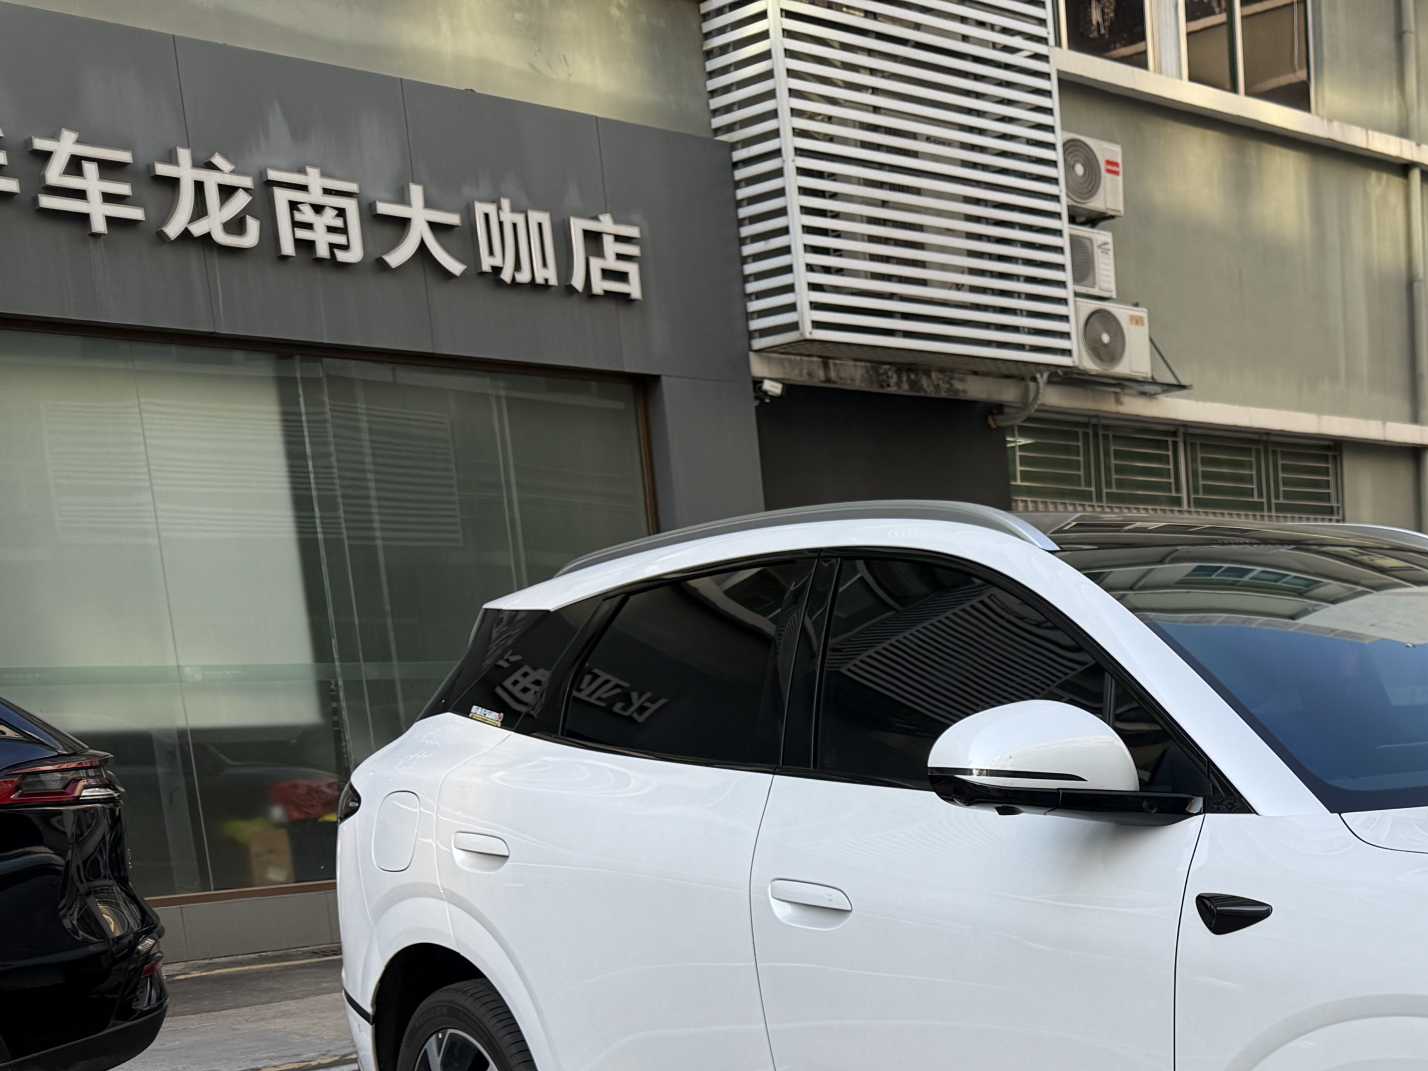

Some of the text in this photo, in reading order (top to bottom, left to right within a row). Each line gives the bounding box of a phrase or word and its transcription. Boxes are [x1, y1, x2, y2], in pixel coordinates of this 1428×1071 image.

[0, 127, 643, 301] 车龙南大咖店
